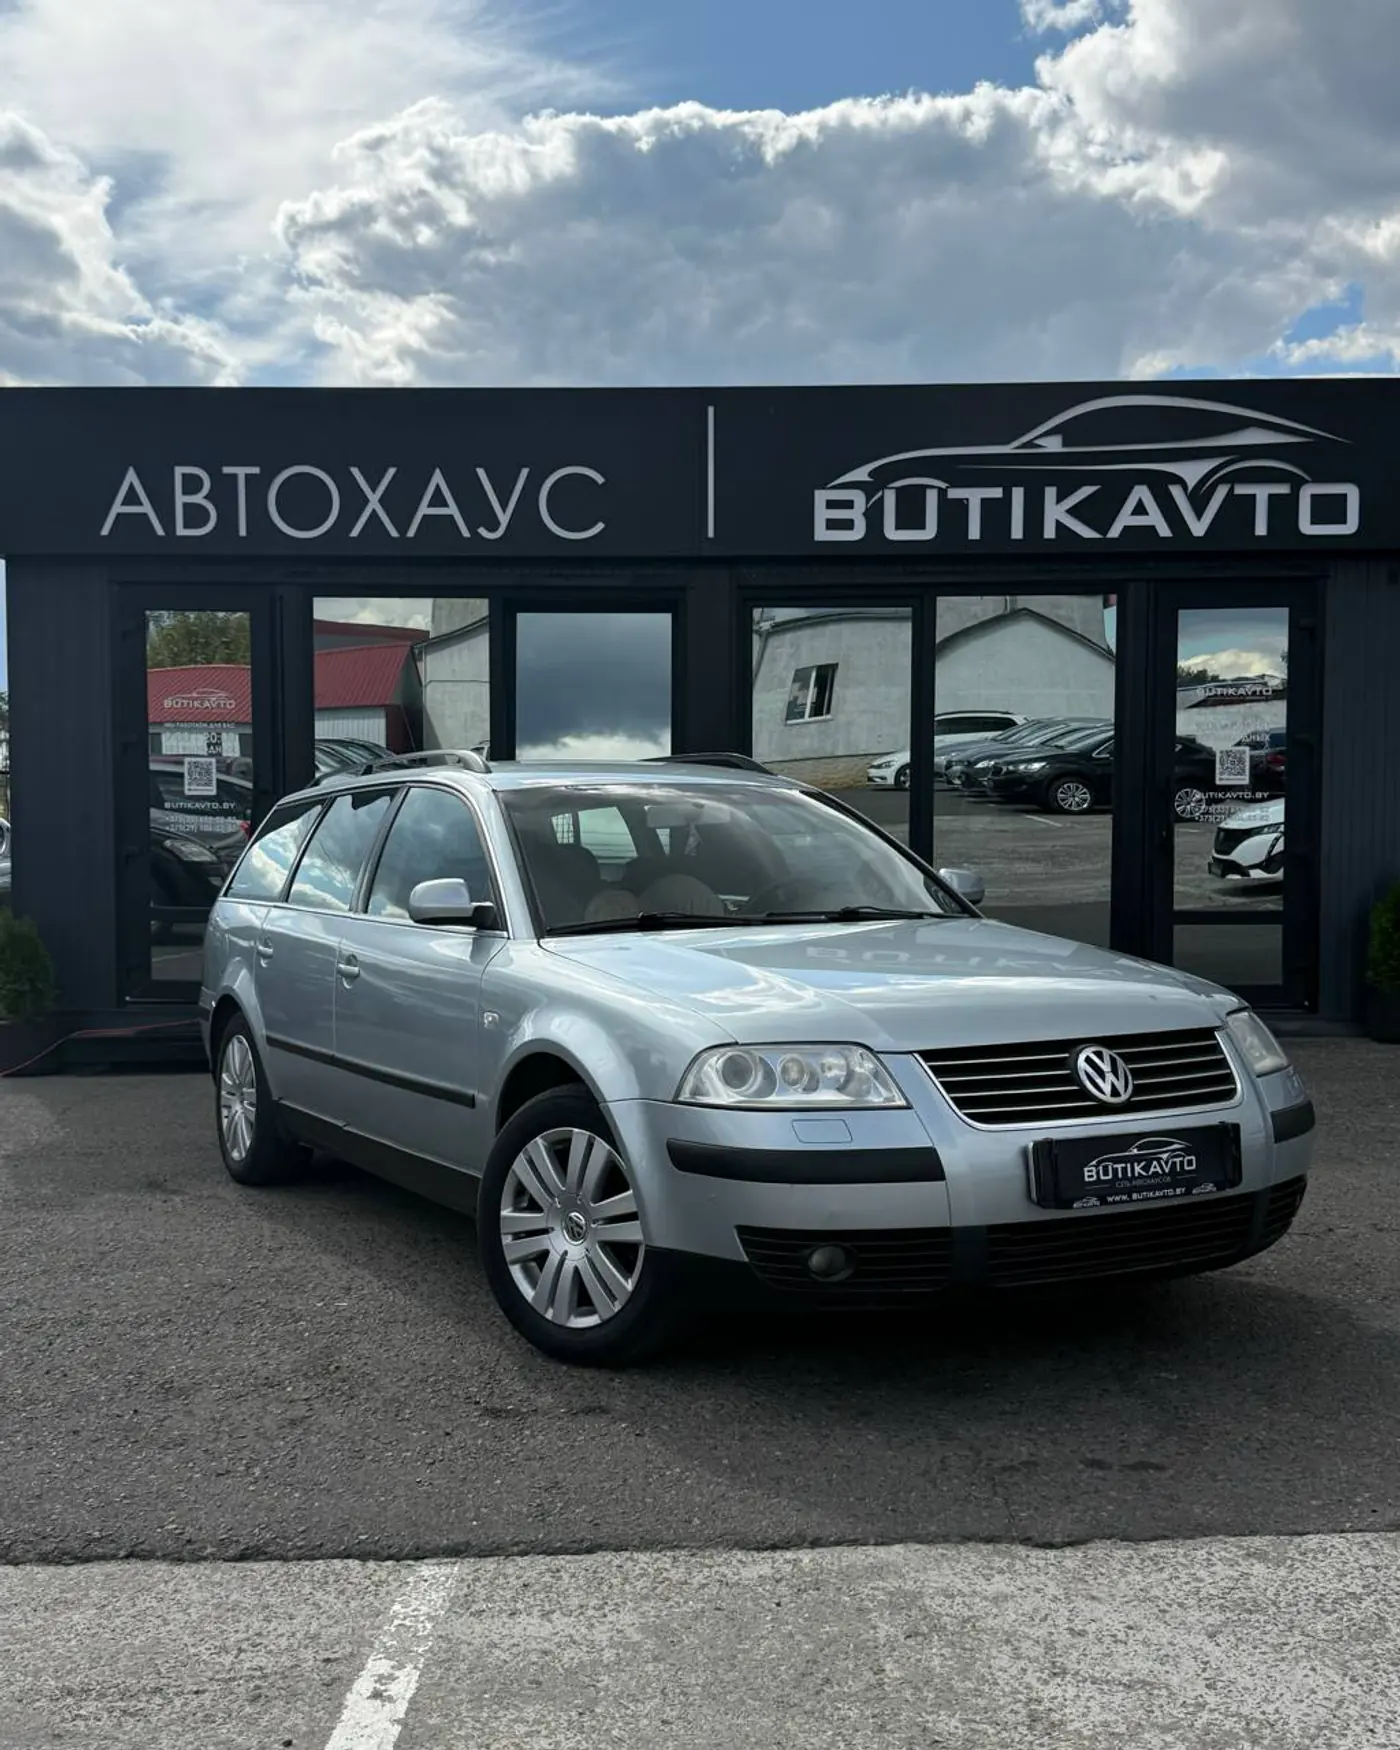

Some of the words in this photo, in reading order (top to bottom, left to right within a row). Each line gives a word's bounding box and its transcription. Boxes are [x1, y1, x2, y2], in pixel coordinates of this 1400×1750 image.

[100, 464, 606, 541] АВТОХАУС
[813, 482, 1360, 542] BUTIKAVTO
[163, 699, 236, 709] BUTIKAVTO
[1083, 1156, 1196, 1182] BUTIKAVTO
